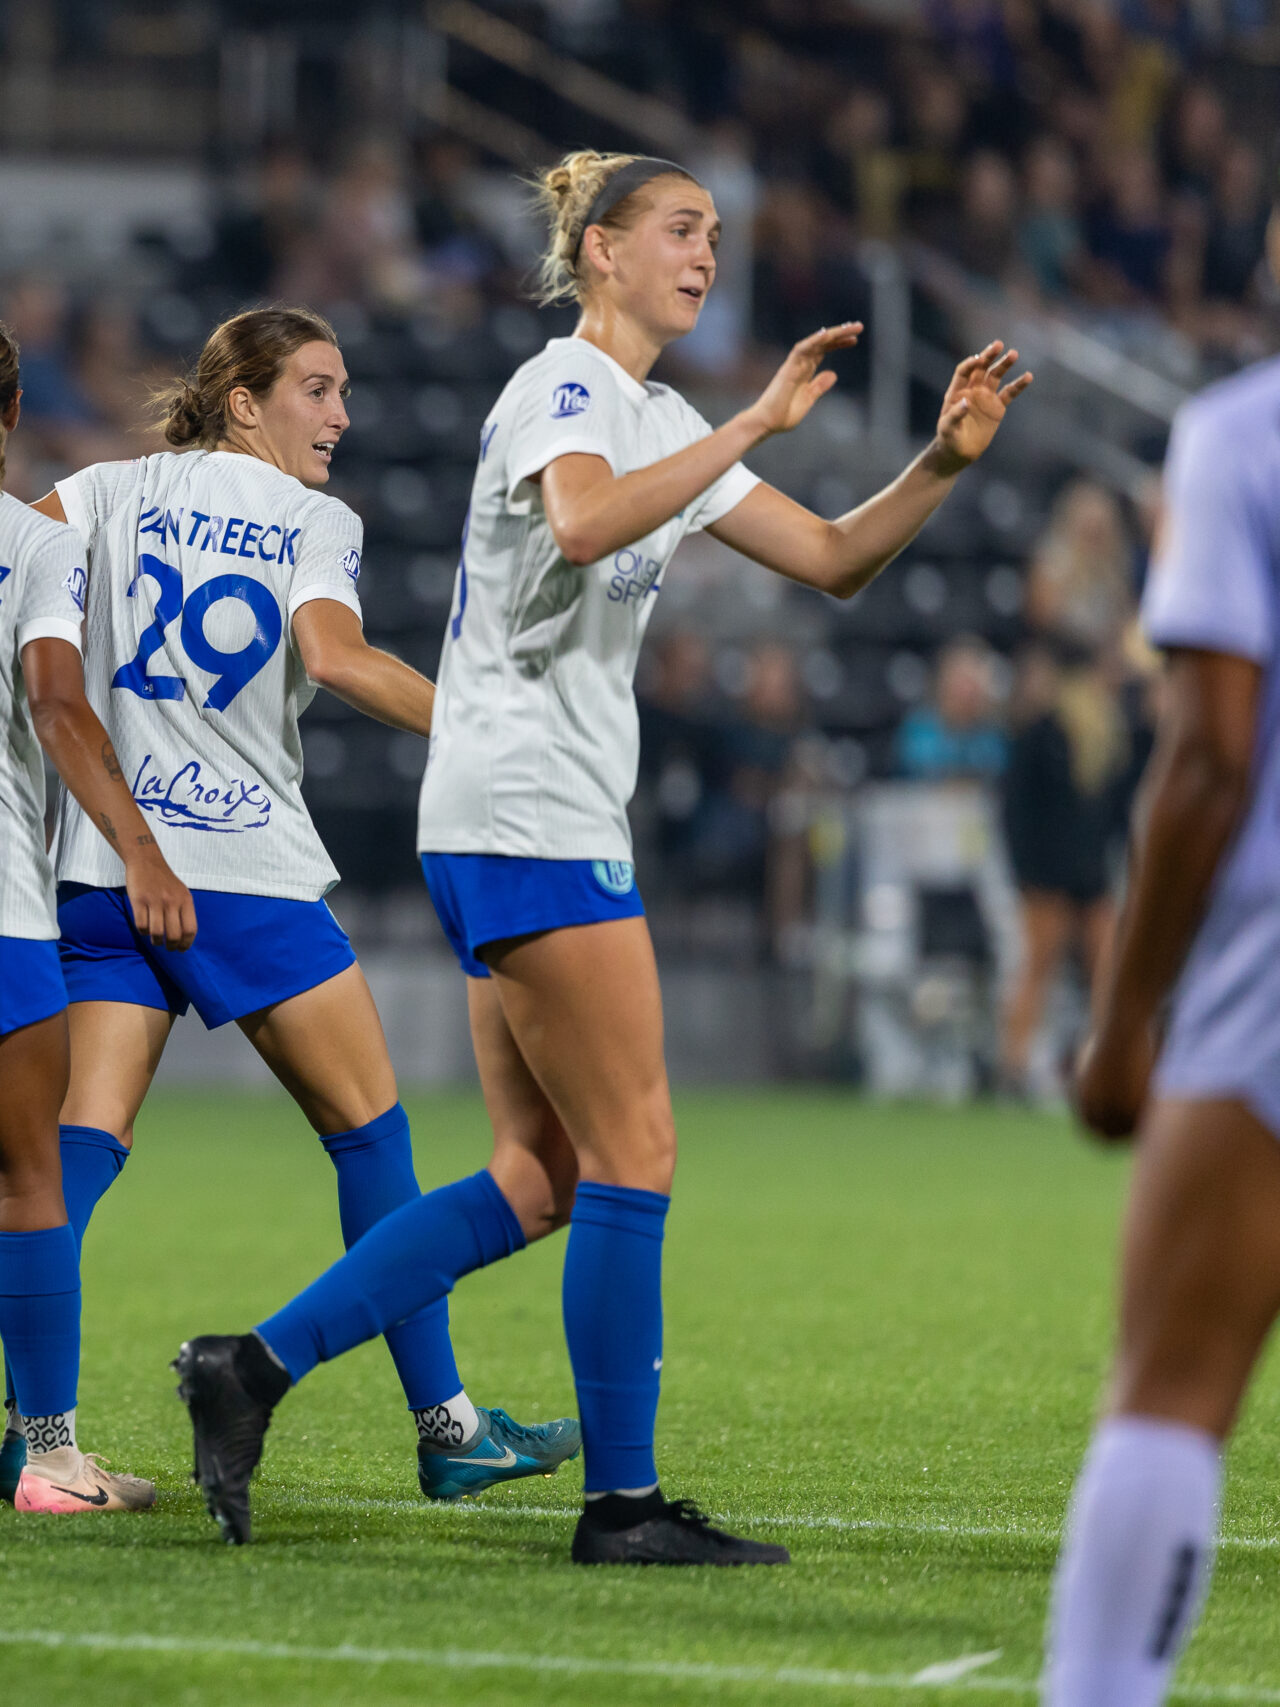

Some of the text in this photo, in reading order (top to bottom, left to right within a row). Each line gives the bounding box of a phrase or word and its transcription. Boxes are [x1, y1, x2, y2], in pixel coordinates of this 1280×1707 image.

[187, 510, 301, 566] TREECK
[111, 553, 282, 713] 29
[131, 753, 272, 832] LaCroix
